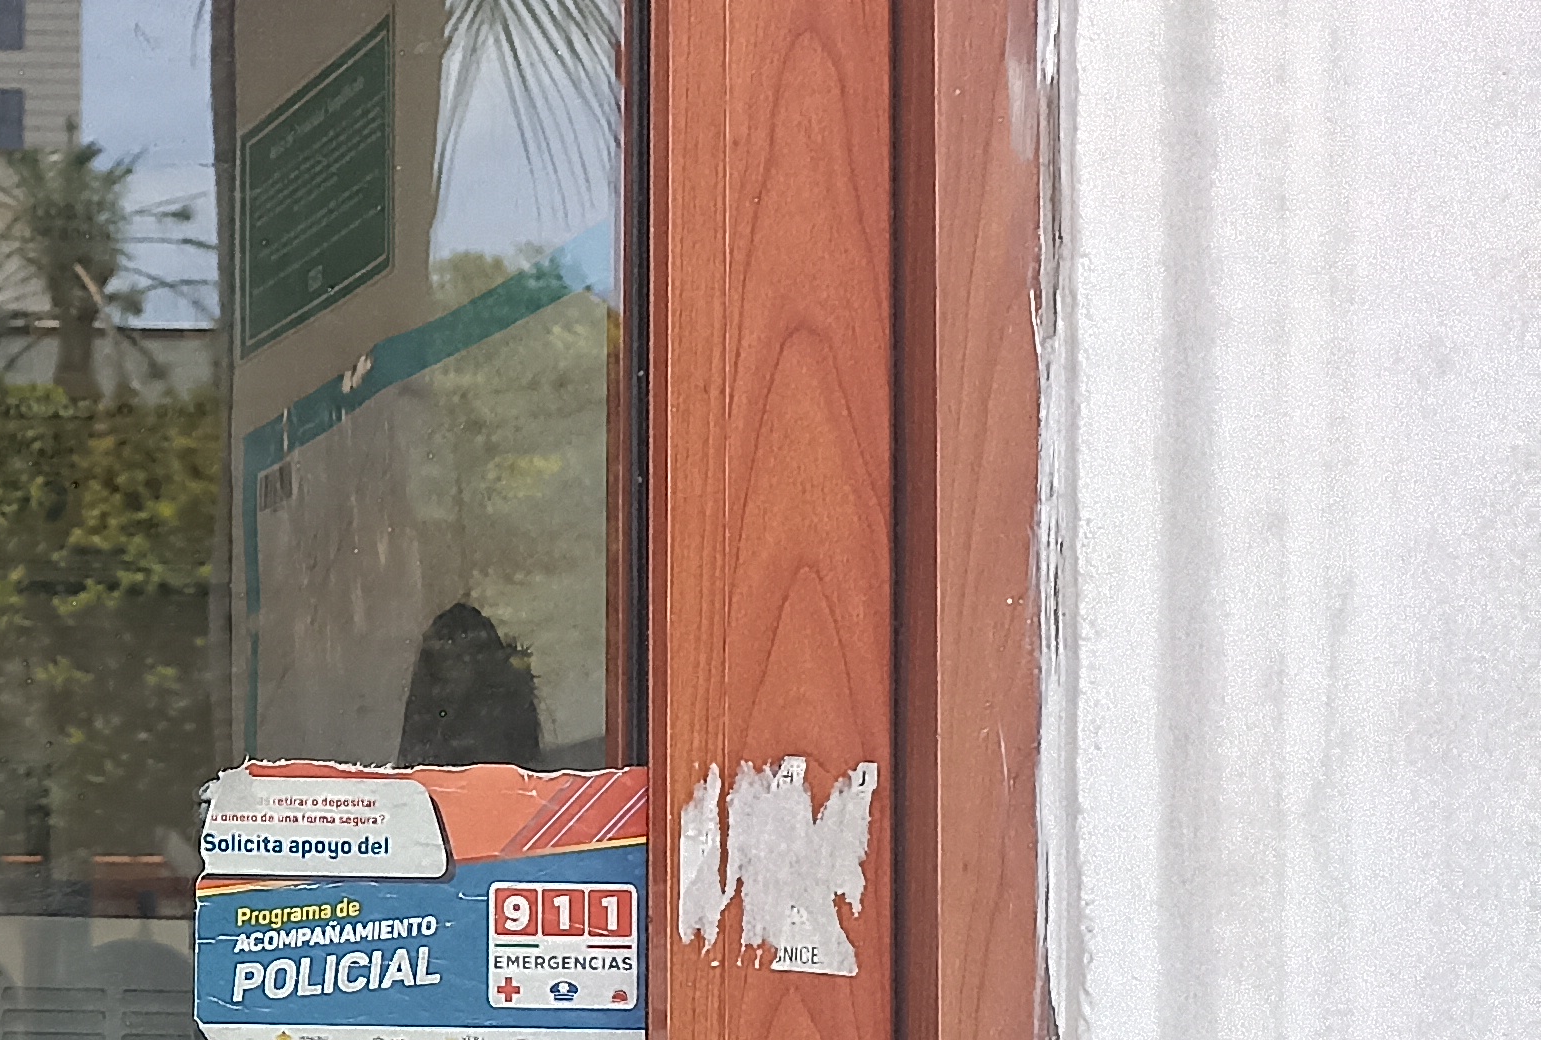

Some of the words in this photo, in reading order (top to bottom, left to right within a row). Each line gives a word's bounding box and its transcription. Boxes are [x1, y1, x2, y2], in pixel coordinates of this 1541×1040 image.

[321, 797, 377, 809] depositar
[277, 815, 299, 823] una
[301, 813, 336, 824] forma
[338, 814, 386, 827] segura?
[203, 833, 284, 853] Solicita
[288, 839, 352, 859] apoyo
[357, 836, 389, 855] del
[237, 904, 332, 928] Programa
[336, 898, 360, 918] de
[233, 915, 437, 953] ACOMPAÑAMIENTO
[232, 946, 441, 1002] POLICIAL
[493, 955, 633, 971] EMERGENCIAS
